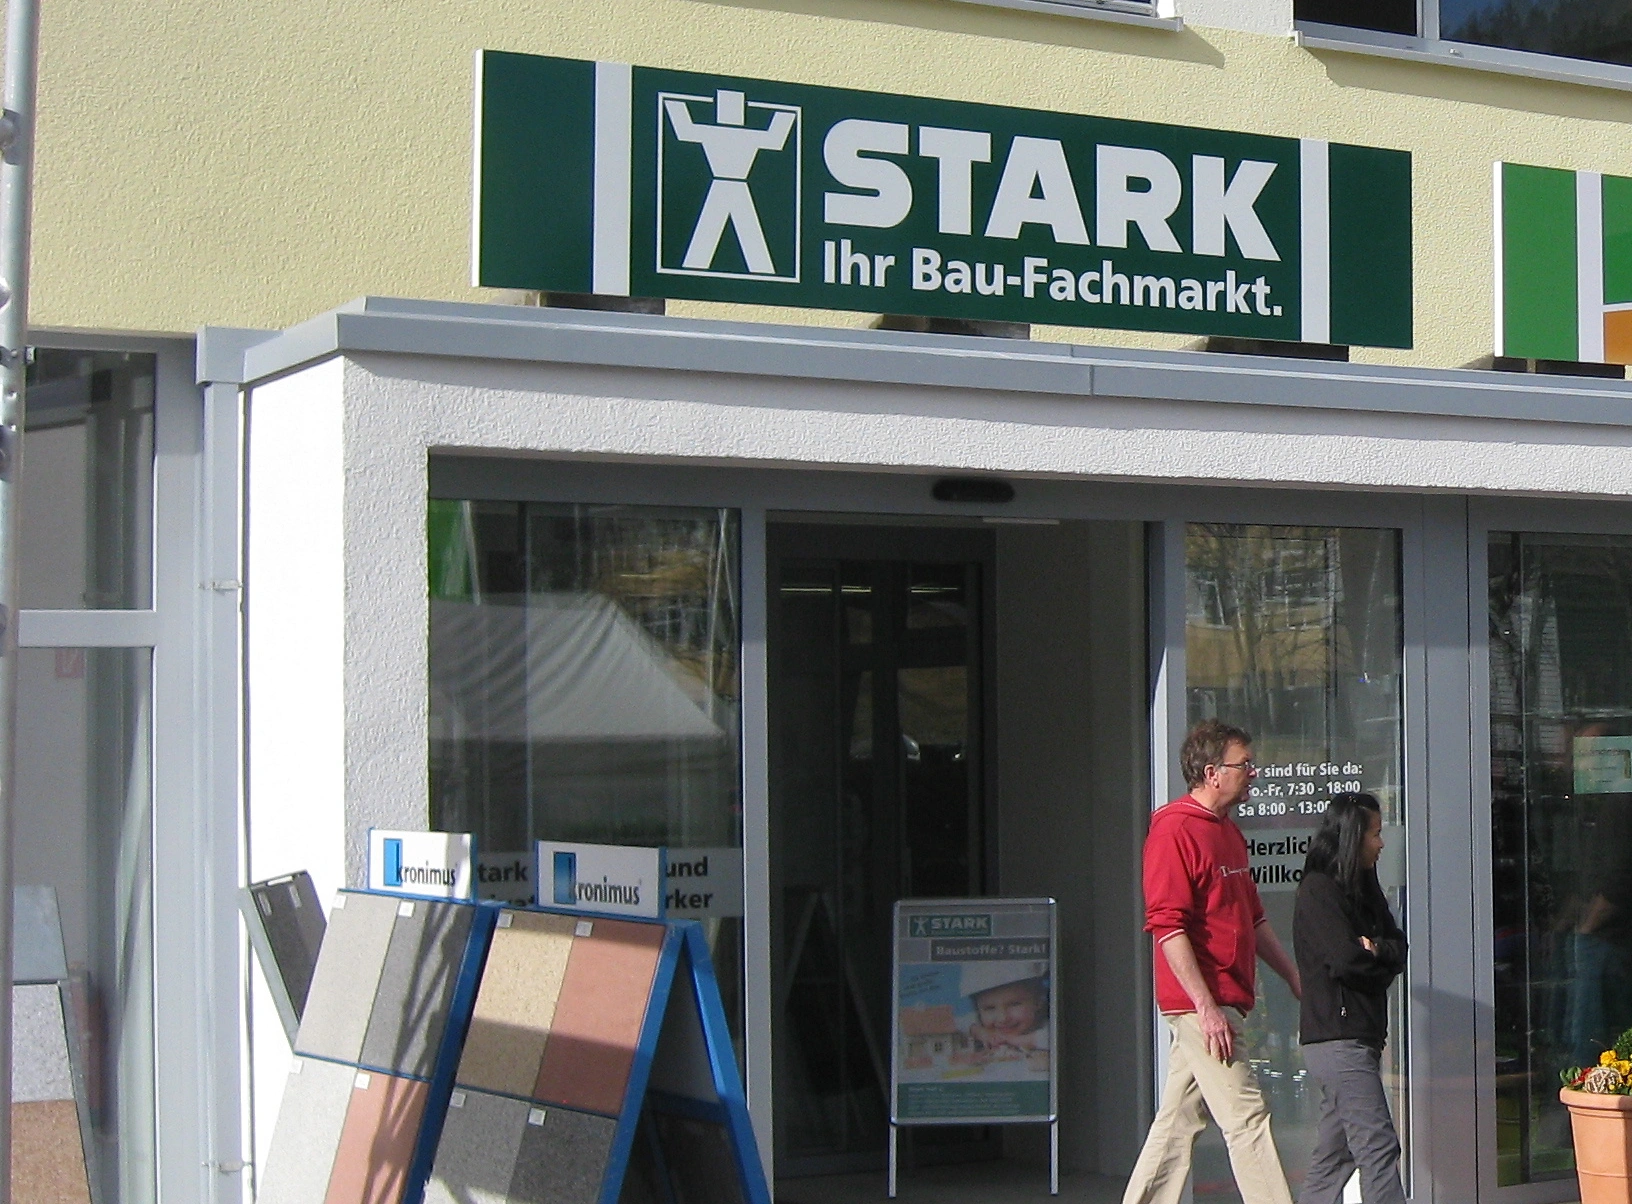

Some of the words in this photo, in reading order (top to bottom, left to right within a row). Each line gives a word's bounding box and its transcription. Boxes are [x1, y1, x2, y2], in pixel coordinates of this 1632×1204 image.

[823, 118, 1282, 262] STARK
[824, 238, 895, 288] Ihr
[911, 246, 1283, 318] Bau-Fachmarkt.
[1264, 763, 1293, 777] sind
[1296, 763, 1316, 777] für
[1319, 762, 1339, 776] Sie
[1342, 761, 1363, 775] da:
[1287, 782, 1315, 796] 7:30
[1326, 780, 1361, 794] 18:00
[1238, 803, 1255, 817] Sa
[1258, 802, 1286, 816] 8:00
[478, 860, 529, 883] tark
[1249, 864, 1304, 884] Willko
[931, 917, 988, 930] STARK
